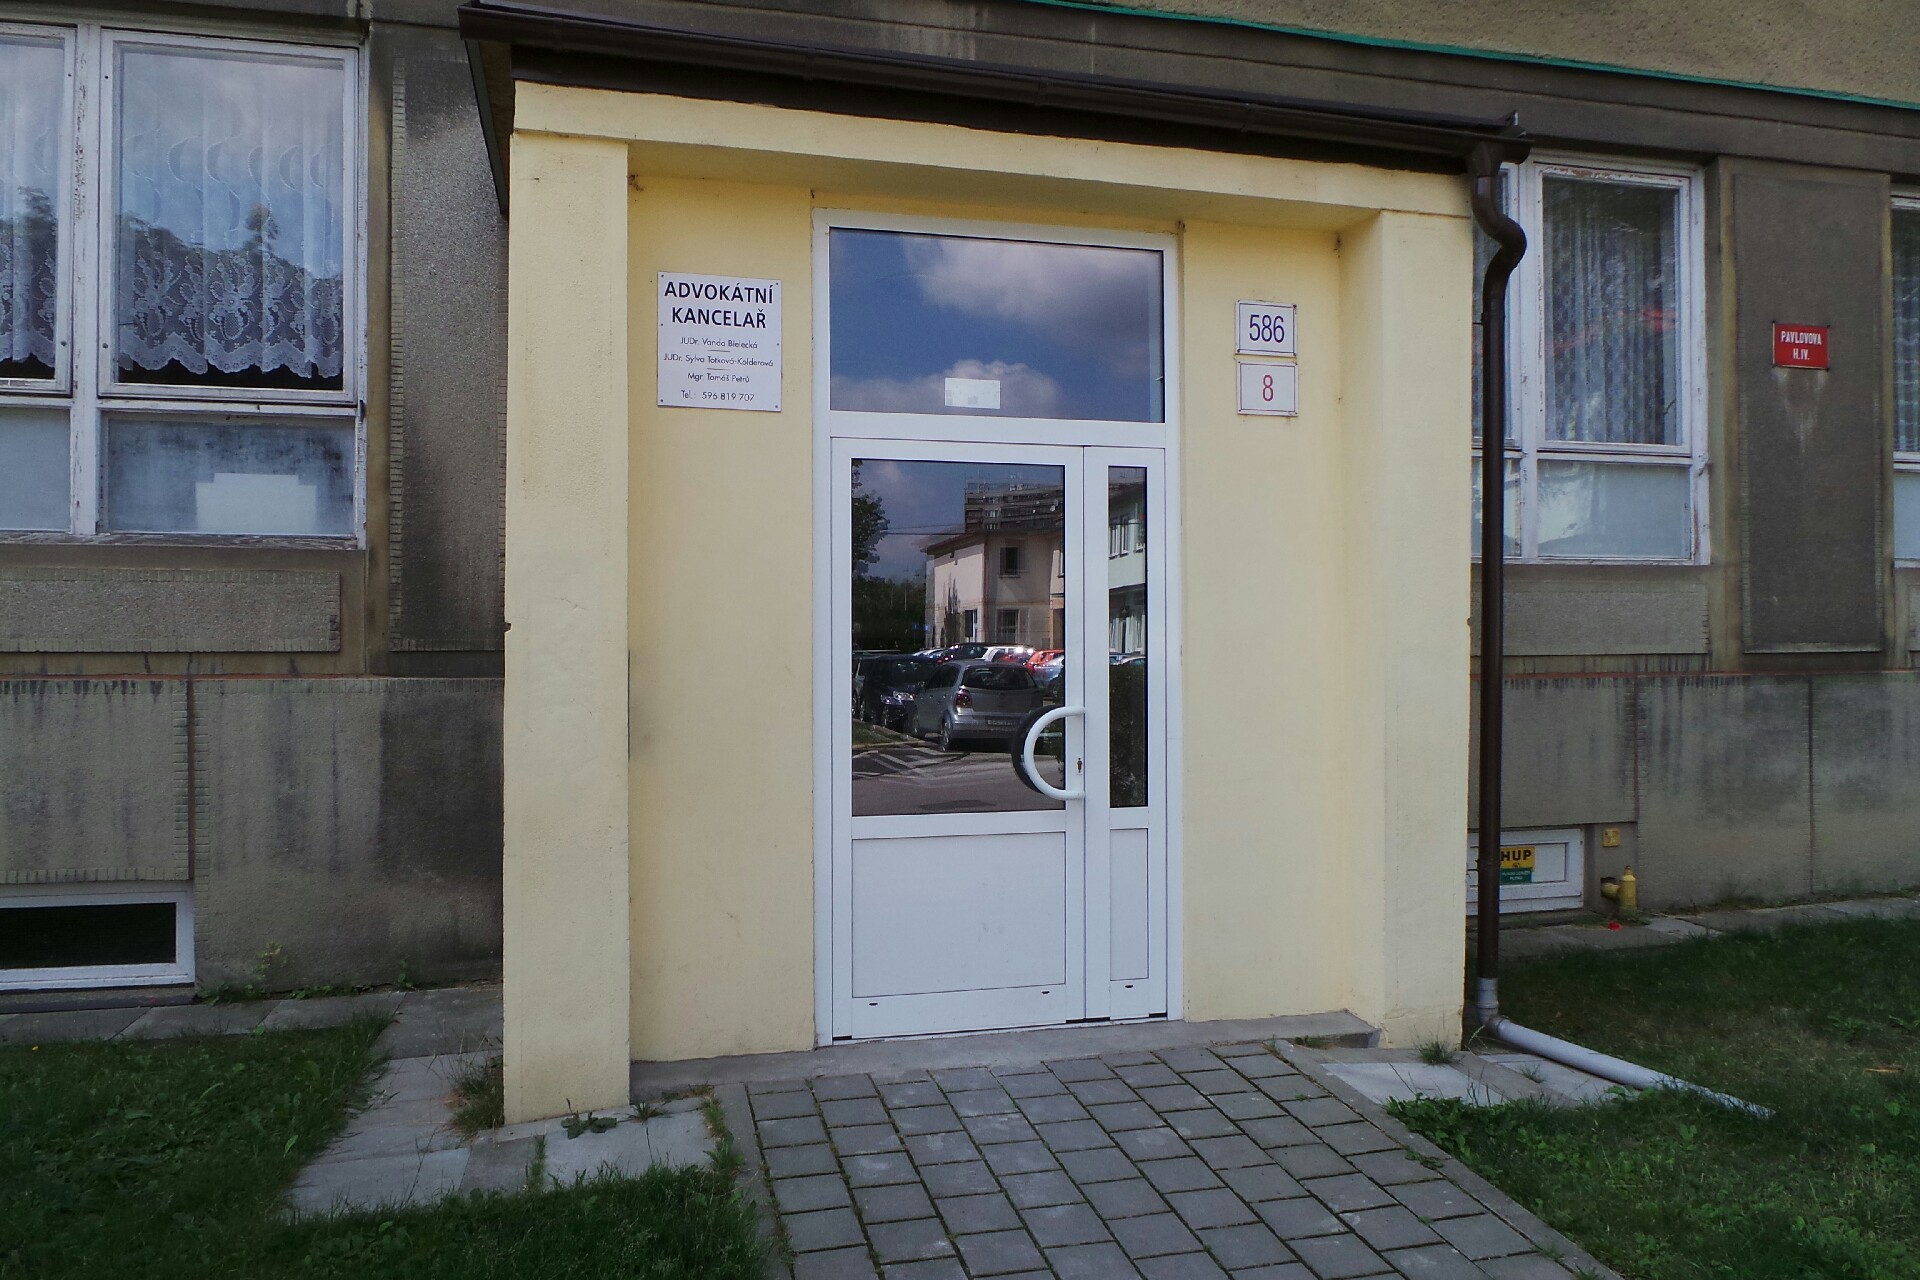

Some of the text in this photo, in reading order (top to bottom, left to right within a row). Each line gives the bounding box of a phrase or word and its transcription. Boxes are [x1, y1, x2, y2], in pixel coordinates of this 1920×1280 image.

[664, 281, 773, 304] ADVOKÁTNÍ
[672, 307, 766, 329] KANCELAŘ
[1249, 314, 1285, 343] 586
[702, 337, 726, 347] Vanda
[728, 339, 758, 349] Bielecká
[1781, 330, 1822, 345] PAVLOVOVA
[664, 353, 682, 362] JUDr.
[685, 354, 705, 364] Sylva
[706, 372, 730, 382] Tomáš
[732, 374, 750, 383] Petrů
[1262, 374, 1274, 402] 8
[701, 391, 718, 400] 596
[720, 392, 737, 401] 819
[739, 393, 755, 402] 707
[1500, 849, 1532, 861] HUP
